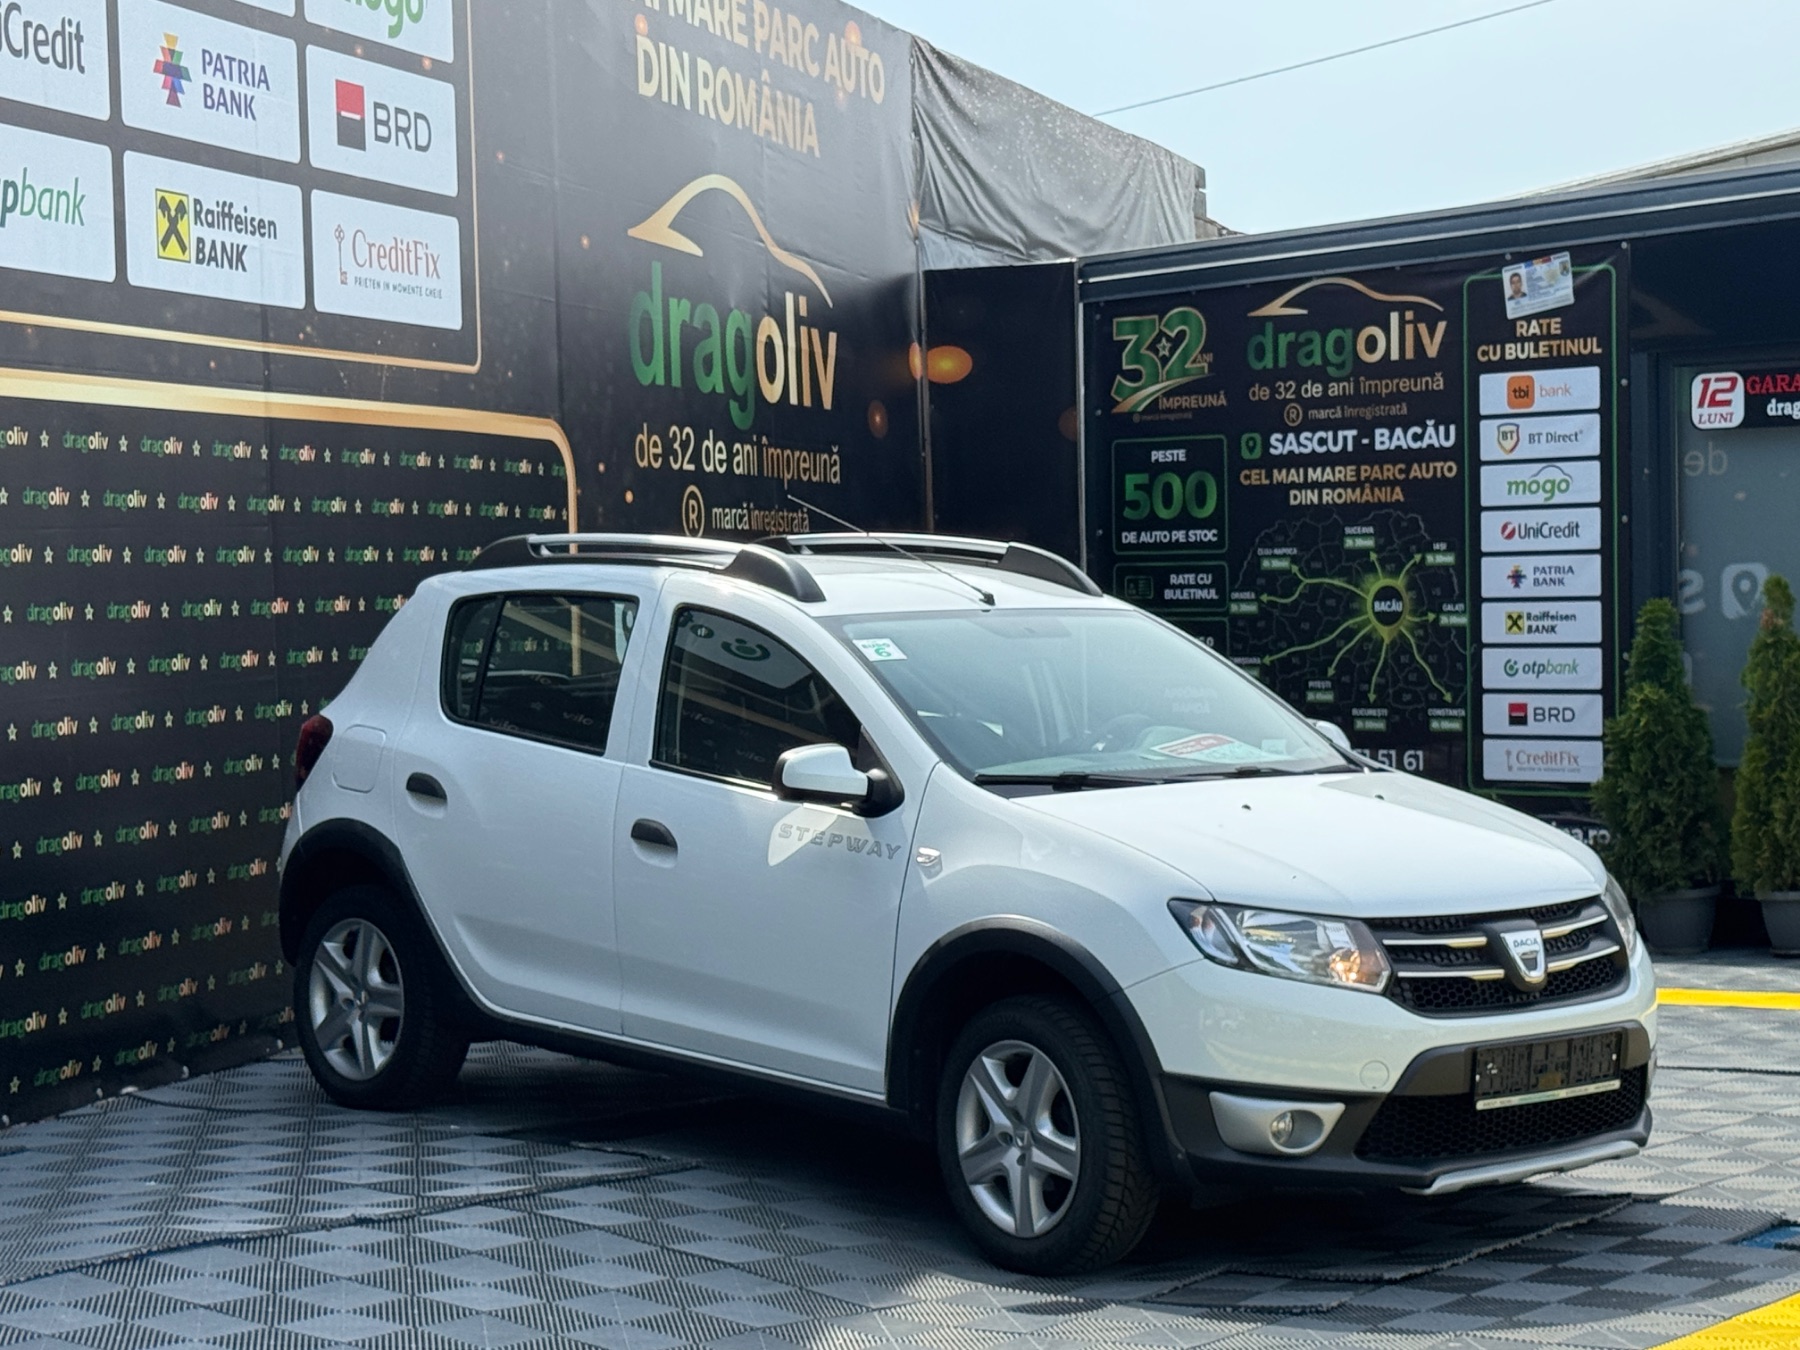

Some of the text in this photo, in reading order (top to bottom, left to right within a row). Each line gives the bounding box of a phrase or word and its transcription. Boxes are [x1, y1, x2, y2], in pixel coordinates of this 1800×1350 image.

[0, 2, 85, 74] Credit
[754, 0, 821, 77] PARC
[824, 33, 885, 104] AUTO
[202, 48, 270, 92] PATRIA
[203, 84, 256, 121] BANK
[636, 34, 820, 158] DIN ROMÂNIA
[373, 101, 432, 153] BRD
[0, 167, 86, 228] pbank
[194, 198, 277, 241] Raiffeisen
[195, 237, 247, 272] BANK
[352, 229, 441, 279] CreditFix
[1247, 310, 1447, 377] dragoliv
[1515, 317, 1562, 337] RATE
[629, 260, 837, 430] dragoliv
[1111, 306, 1207, 403] 32
[1477, 337, 1602, 361] CU BULETINUL
[1249, 373, 1444, 400] de 32 de ani împreună
[1512, 383, 1572, 399] tbi bank
[1697, 376, 1738, 409] 12
[1308, 405, 1342, 420] marcă
[1344, 402, 1408, 422] înregistrată
[1698, 412, 1735, 424] LUNI
[62, 431, 109, 453] dragoliv
[140, 436, 183, 458] dragoliv
[212, 440, 252, 462] dragoliv
[279, 445, 316, 464] dragoliv
[341, 448, 376, 468] dragoliv
[1270, 430, 1357, 455] SASCUT
[1374, 420, 1456, 451] BACĂU
[1502, 430, 1515, 440] BT
[1528, 433, 1542, 444] BT
[635, 422, 841, 490] de 32 de ani împreună
[1151, 450, 1187, 463] PESTE
[1240, 461, 1457, 486] CEL MAI MARE PARC AUTO
[1507, 478, 1570, 502] mogo
[22, 487, 70, 510] dragoliv
[103, 489, 147, 511] dragoliv
[178, 492, 219, 513] dragoliv
[247, 494, 285, 515] dragoliv
[311, 497, 347, 516] dragoliv
[1122, 471, 1217, 520] 500
[1289, 484, 1404, 506] DIN ROMÂNIA
[712, 502, 749, 532] marcă
[750, 501, 810, 536] înregistrată
[1518, 521, 1580, 539] UniCredit
[1121, 529, 1218, 544] DE AUTO PE STOC
[67, 545, 112, 567] dragoliv
[144, 546, 187, 566] dragoliv
[216, 546, 255, 567] dragoliv
[282, 546, 319, 566] dragoliv
[345, 546, 379, 565] dragoliv
[1533, 566, 1574, 576] PATRIA
[1163, 588, 1219, 600] BULETINUL
[1170, 573, 1213, 585] RATE CU
[1533, 577, 1565, 587] BANK
[27, 602, 74, 625] dragoliv
[107, 601, 151, 623] dragoliv
[181, 599, 222, 621] dragoliv
[251, 598, 289, 618] dragoliv
[315, 595, 350, 616] dragoliv
[1526, 611, 1576, 622] Raiffeisen
[1526, 625, 1557, 635] BANK
[71, 646, 323, 680] dragoliv dragoliv dragoliv dragoliv
[1522, 659, 1579, 678] otpbank
[31, 700, 292, 741] dragoliv dragoliv dragoliv dragoliv
[1533, 707, 1575, 722] BRD
[75, 769, 121, 793] dragoliv
[152, 762, 194, 784] dragoliv
[223, 754, 263, 776] dragoliv
[1403, 749, 1424, 772] 61
[1516, 749, 1580, 766] CreditFix
[36, 811, 230, 856] dragoliv dragoliv dragoliv
[778, 823, 902, 860] STEPWAY
[80, 881, 125, 906] dragoliv
[156, 870, 198, 893] dragoliv
[227, 858, 267, 881] dragoliv
[38, 945, 86, 972] dragoliv
[118, 931, 162, 955] dragoliv
[190, 917, 232, 941] dragoliv
[80, 994, 126, 1020] dragoliv
[157, 978, 198, 1002] dragoliv
[227, 962, 268, 985] dragoliv
[34, 1023, 230, 1087] dragoliv dragoliv dragoliv
